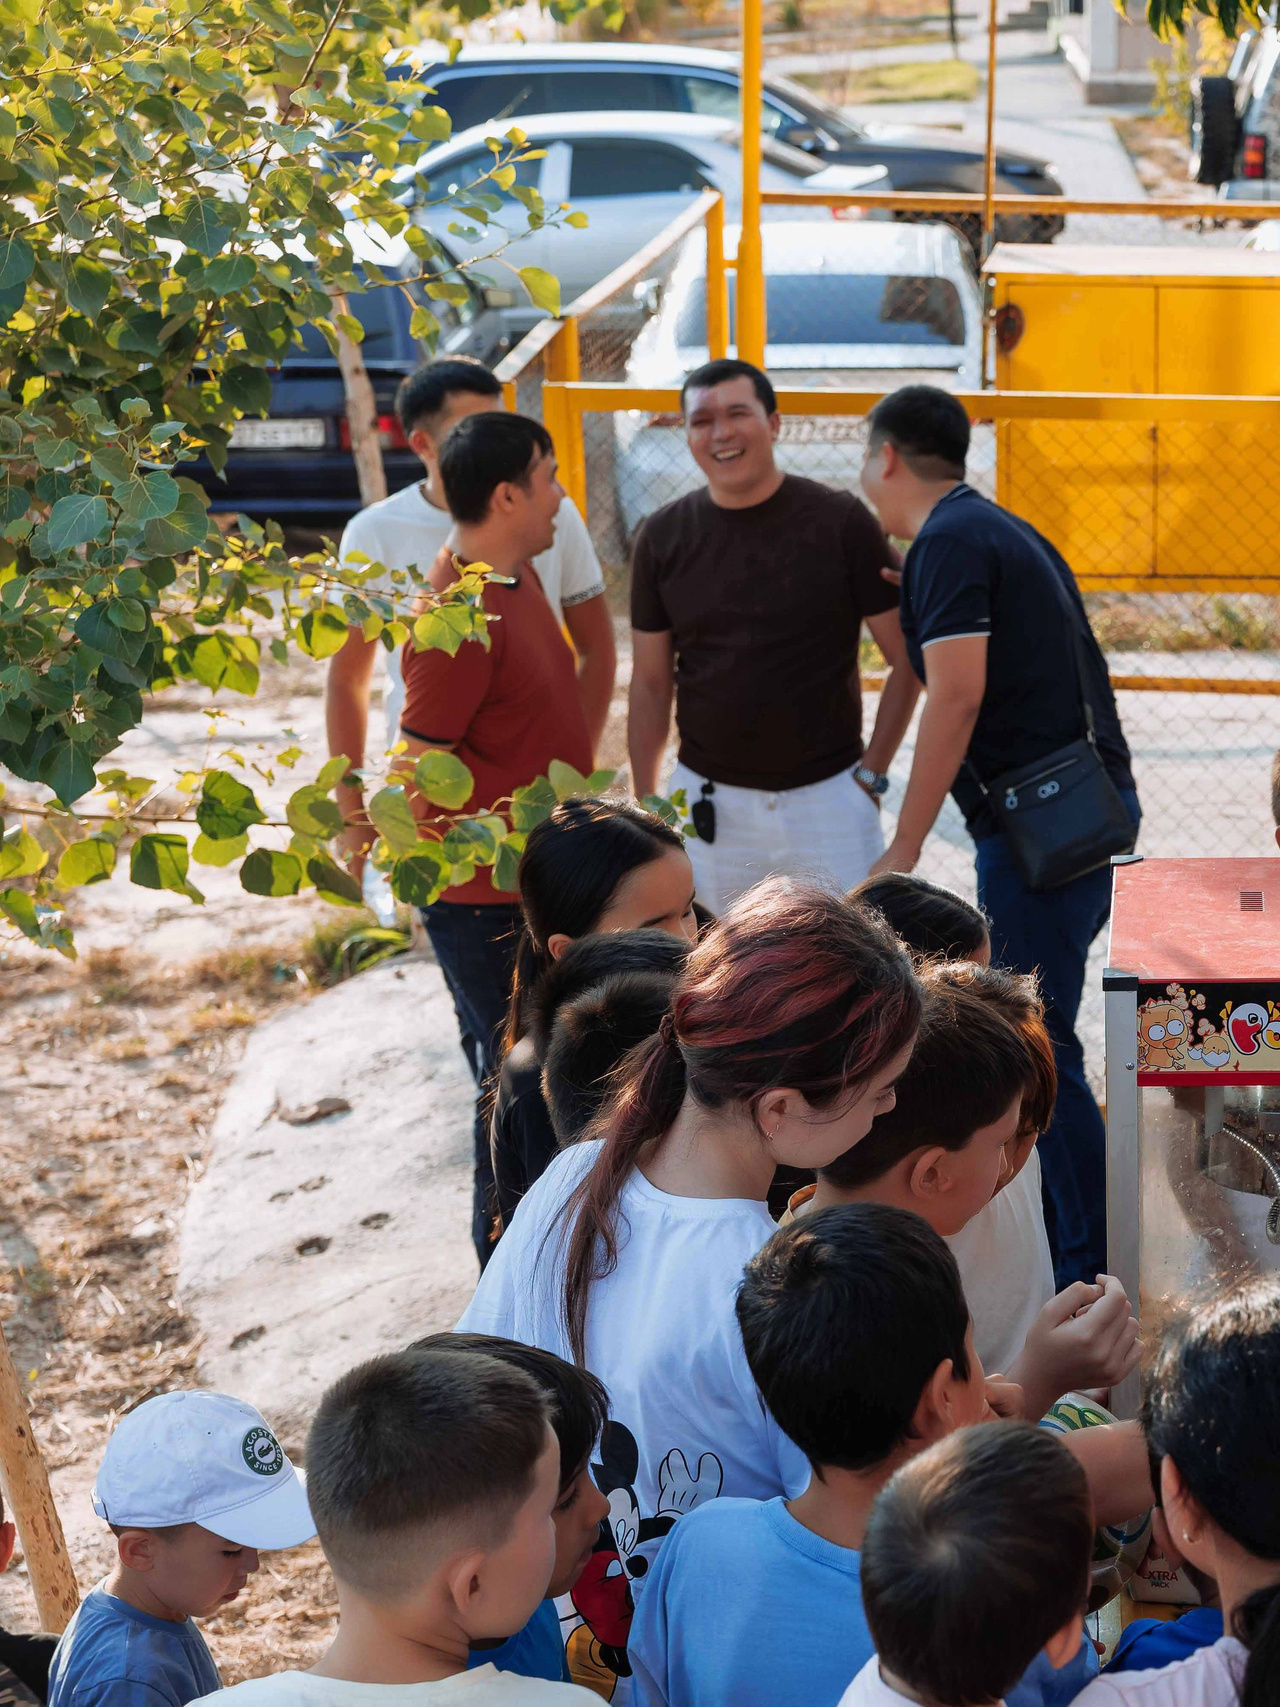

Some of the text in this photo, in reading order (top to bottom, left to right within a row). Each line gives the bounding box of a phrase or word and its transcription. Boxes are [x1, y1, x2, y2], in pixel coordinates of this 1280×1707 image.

[245, 1429, 274, 1460] LACOSTE
[253, 1461, 278, 1472] SINCE
[1151, 1581, 1170, 1589] PACK
